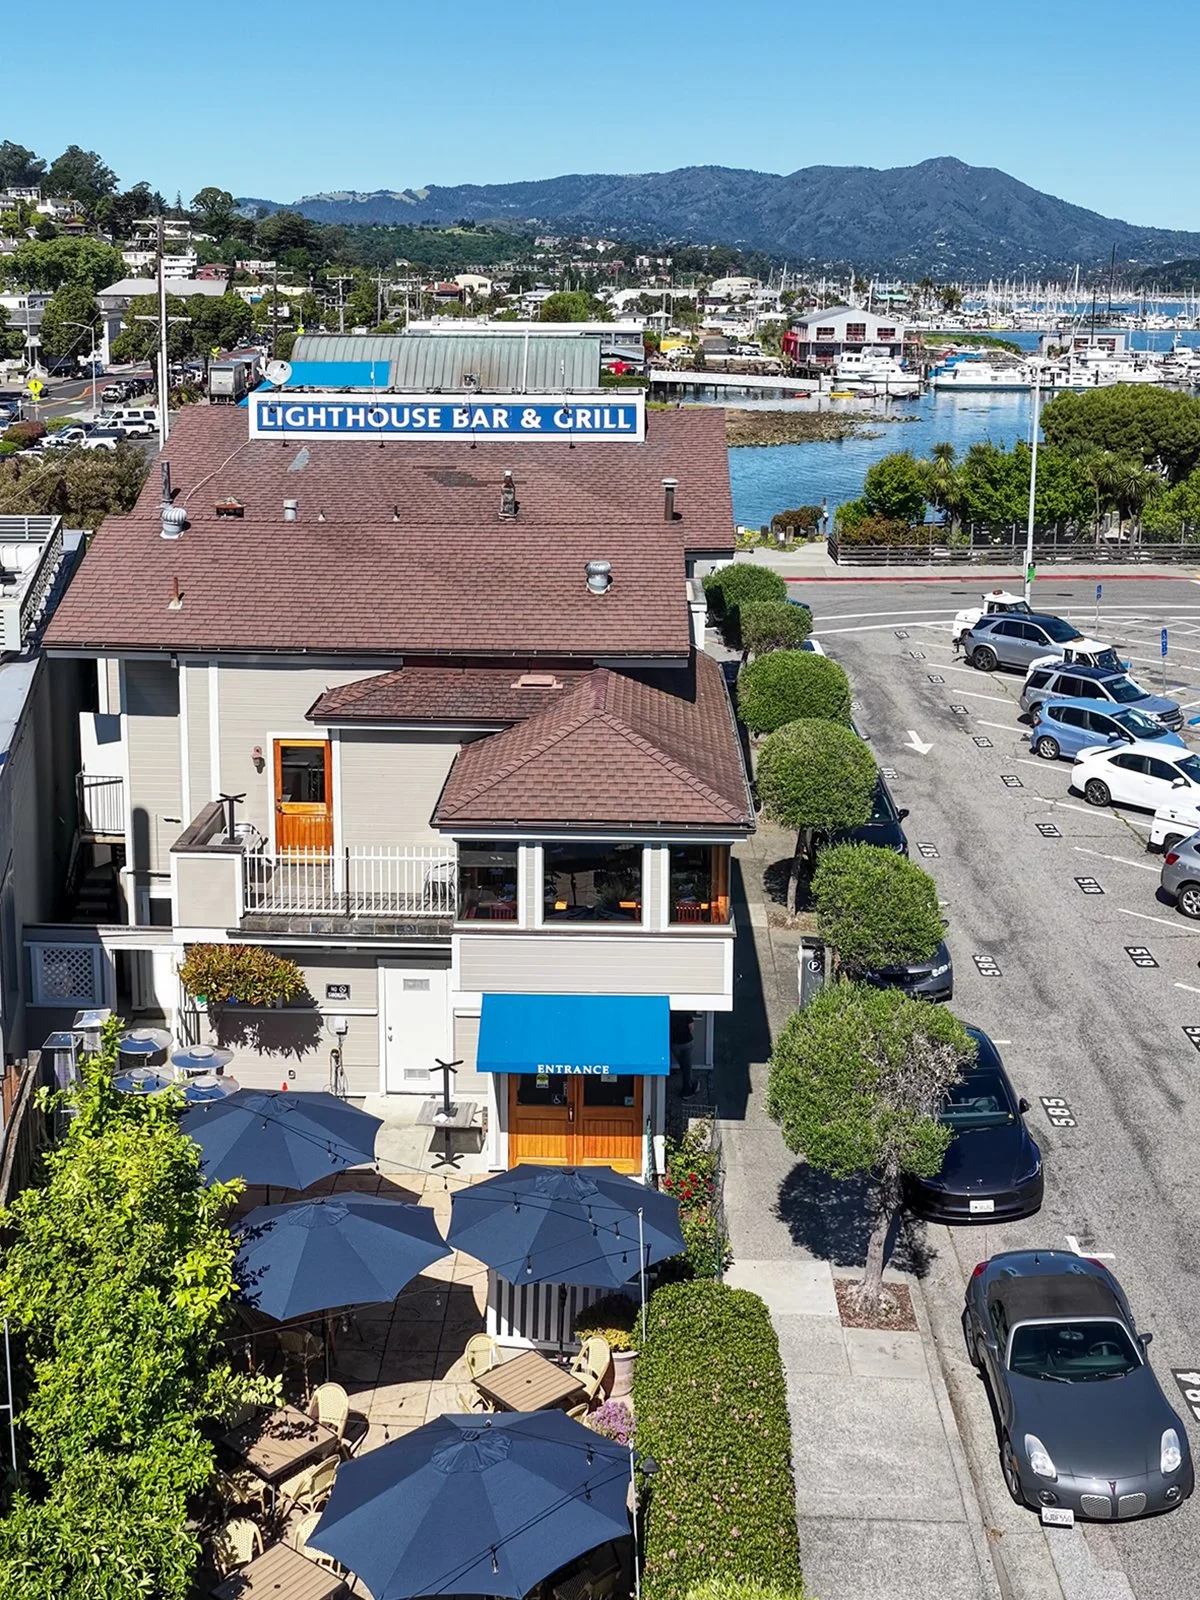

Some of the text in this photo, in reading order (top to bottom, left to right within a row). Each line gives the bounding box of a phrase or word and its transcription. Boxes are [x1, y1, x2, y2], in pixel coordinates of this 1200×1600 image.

[262, 406, 631, 429] LIGHTHOUSE BAR & GRILL
[1038, 825, 1060, 836] 517
[1077, 878, 1102, 893] 518
[974, 956, 1001, 976] 586
[1128, 948, 1156, 966] 519
[537, 1064, 610, 1075] ENTRANCE
[1041, 1097, 1076, 1126] 585
